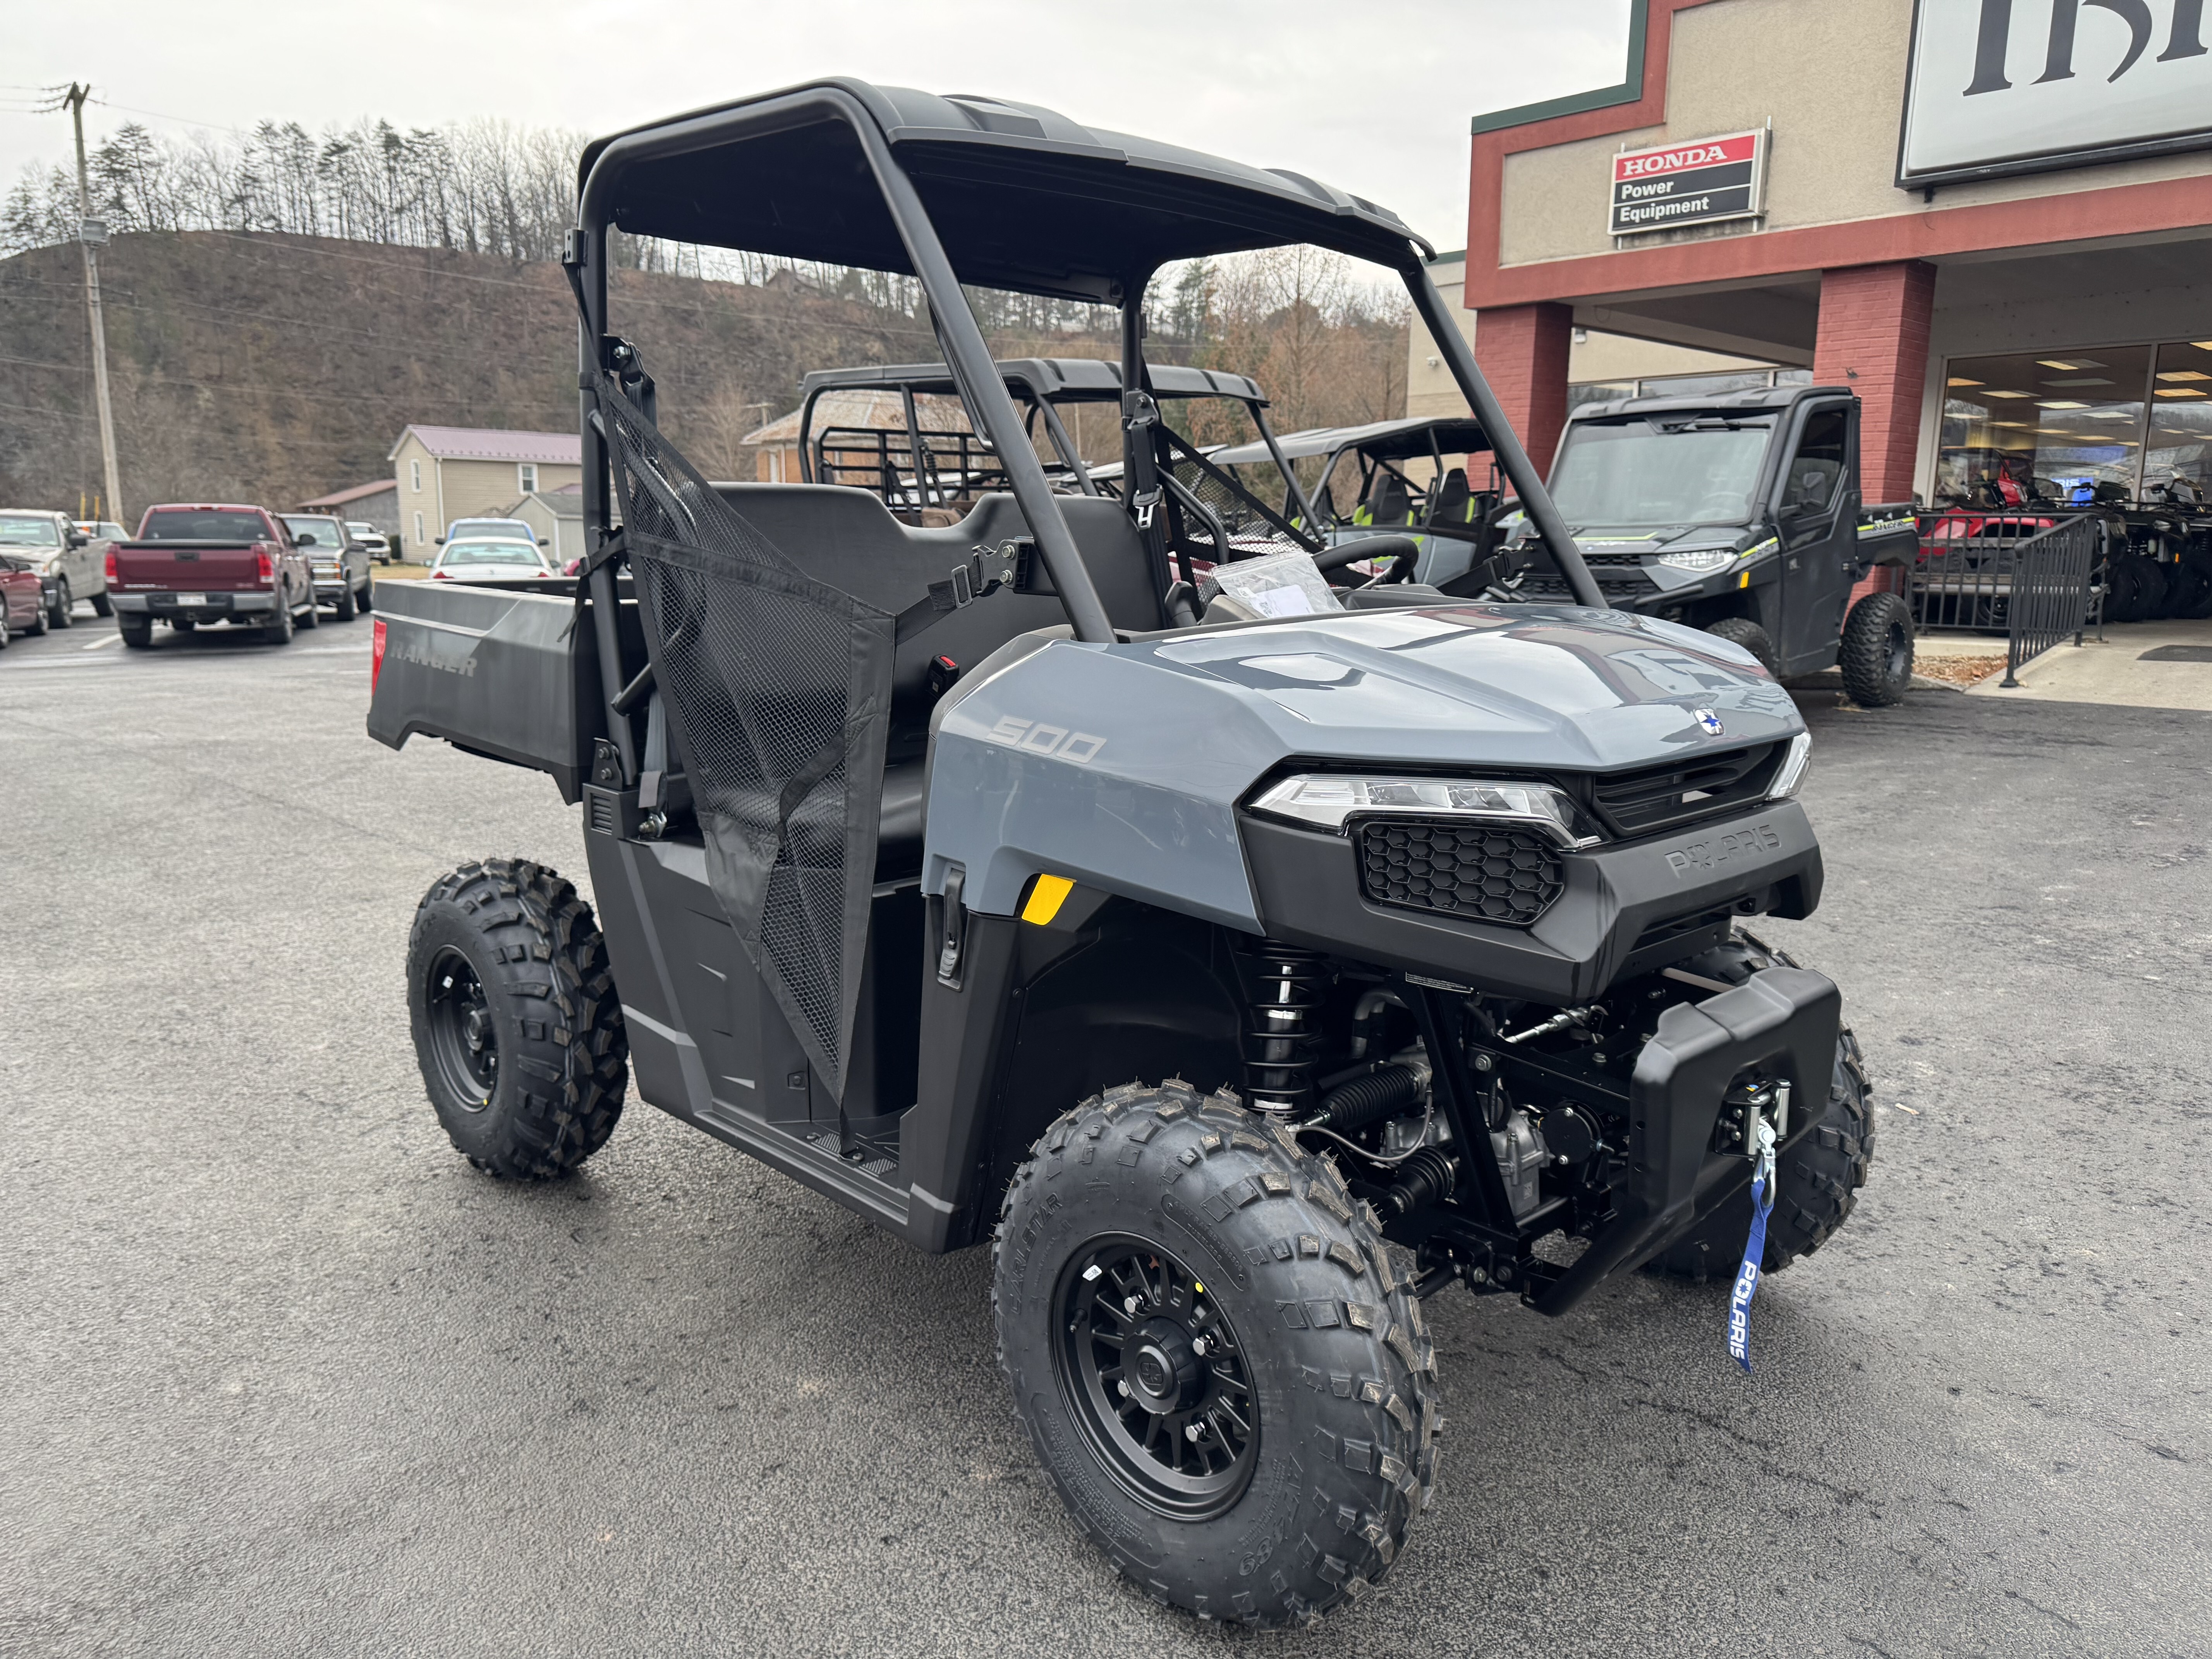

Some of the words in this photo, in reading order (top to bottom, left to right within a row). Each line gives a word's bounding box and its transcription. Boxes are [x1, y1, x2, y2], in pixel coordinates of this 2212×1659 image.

[1623, 145, 1727, 176] HONDA
[1620, 196, 1709, 223] Equipment
[1621, 181, 1674, 199] Power
[390, 640, 477, 678] RANGER
[985, 714, 1107, 764] 500
[1664, 825, 1781, 879] POLARIS
[1010, 1192, 1063, 1314] CARLSTAR
[1730, 1260, 1757, 1360] POLARIS
